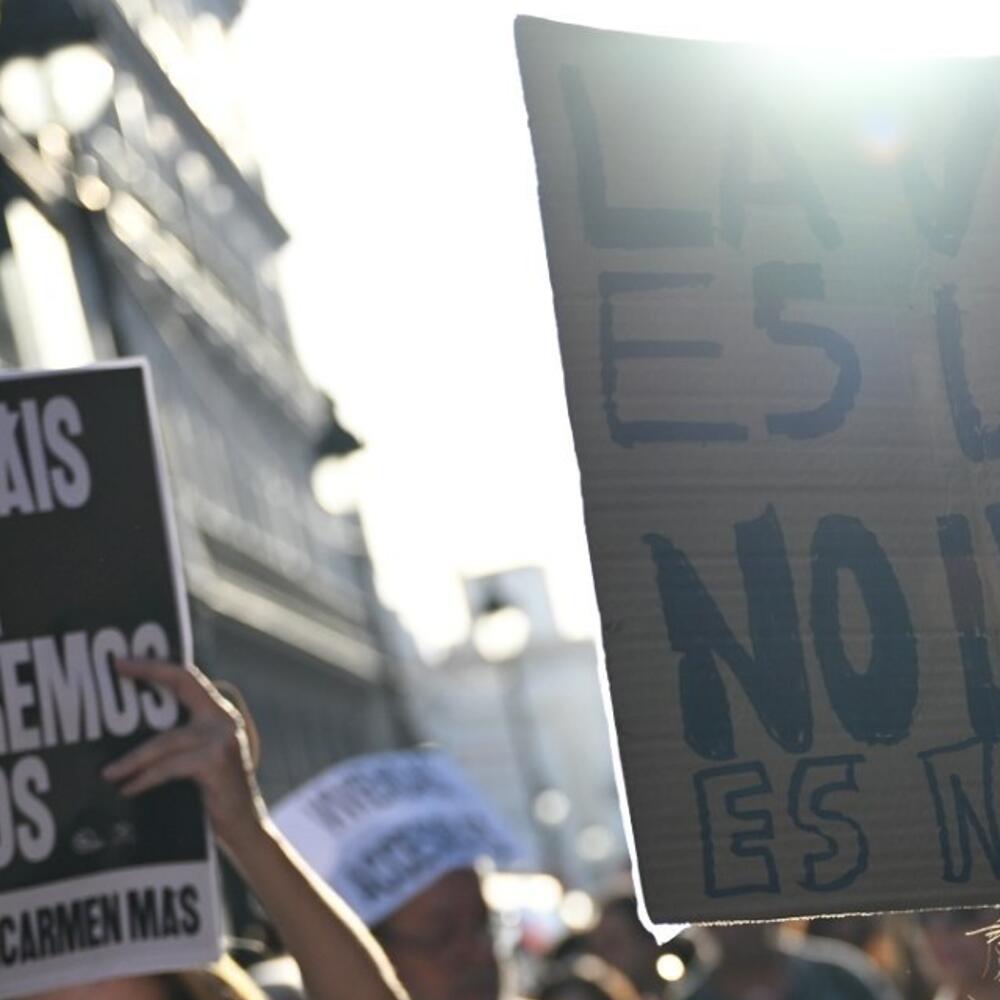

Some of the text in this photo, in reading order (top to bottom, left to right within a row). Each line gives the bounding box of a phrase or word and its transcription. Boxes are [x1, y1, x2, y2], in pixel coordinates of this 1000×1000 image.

[558, 55, 843, 250] LA
[599, 262, 862, 448] ES
[0, 621, 179, 757] EMOS
[643, 502, 919, 760] NO
[694, 752, 870, 897] ES
[0, 889, 123, 966] CARMEN
